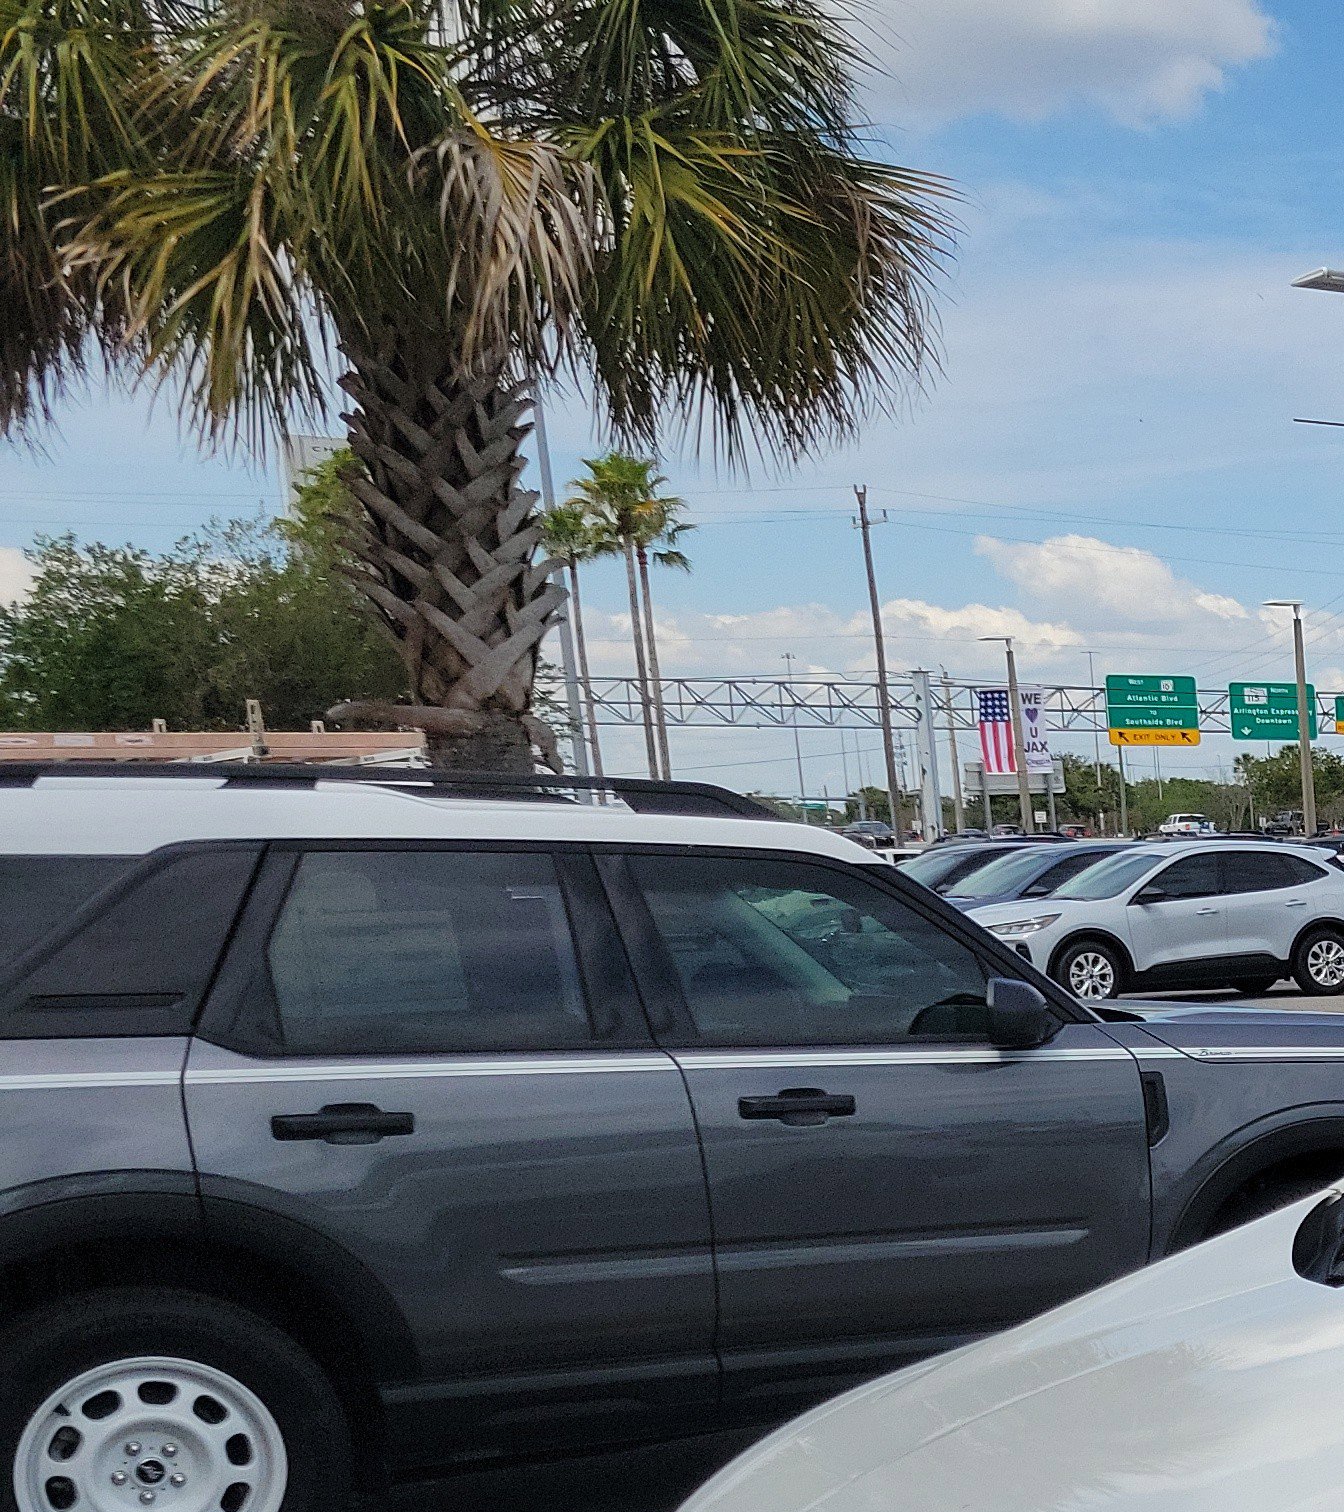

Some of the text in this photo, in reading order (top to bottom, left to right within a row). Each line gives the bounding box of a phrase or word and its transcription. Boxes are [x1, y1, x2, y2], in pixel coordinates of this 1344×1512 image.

[1021, 693, 1042, 705] WE
[1127, 694, 1158, 702] Atlantic
[1233, 707, 1268, 716] Arlington
[1125, 718, 1183, 726] Southside Blvd
[1029, 727, 1038, 738] U
[1133, 733, 1176, 741] EXIT ONLY
[1024, 741, 1049, 753] JAX
